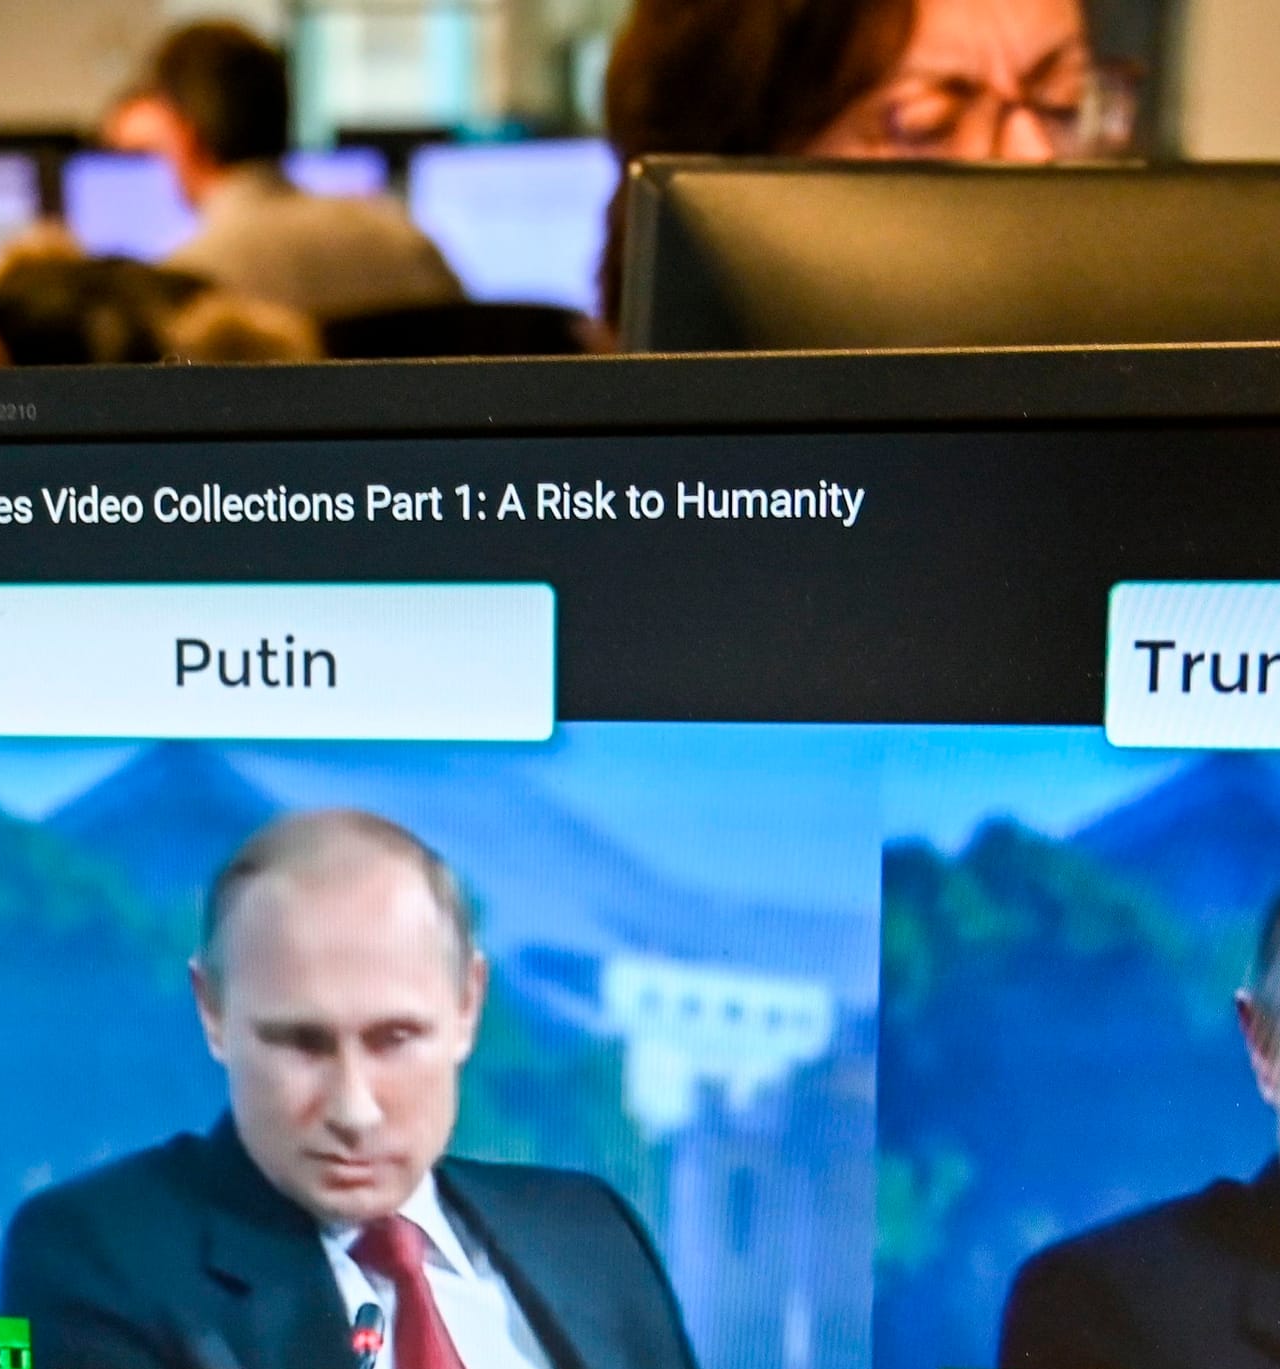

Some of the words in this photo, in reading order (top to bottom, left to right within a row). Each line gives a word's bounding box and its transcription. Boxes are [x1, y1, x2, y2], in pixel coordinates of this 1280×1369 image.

[42, 485, 143, 524] Video
[153, 484, 355, 524] Collections
[367, 483, 443, 521] Part
[455, 483, 486, 520] 1:
[497, 483, 526, 520] A
[537, 480, 617, 520] Risk
[625, 486, 665, 520] to
[677, 480, 865, 528] Humanity
[174, 637, 337, 687] Putin
